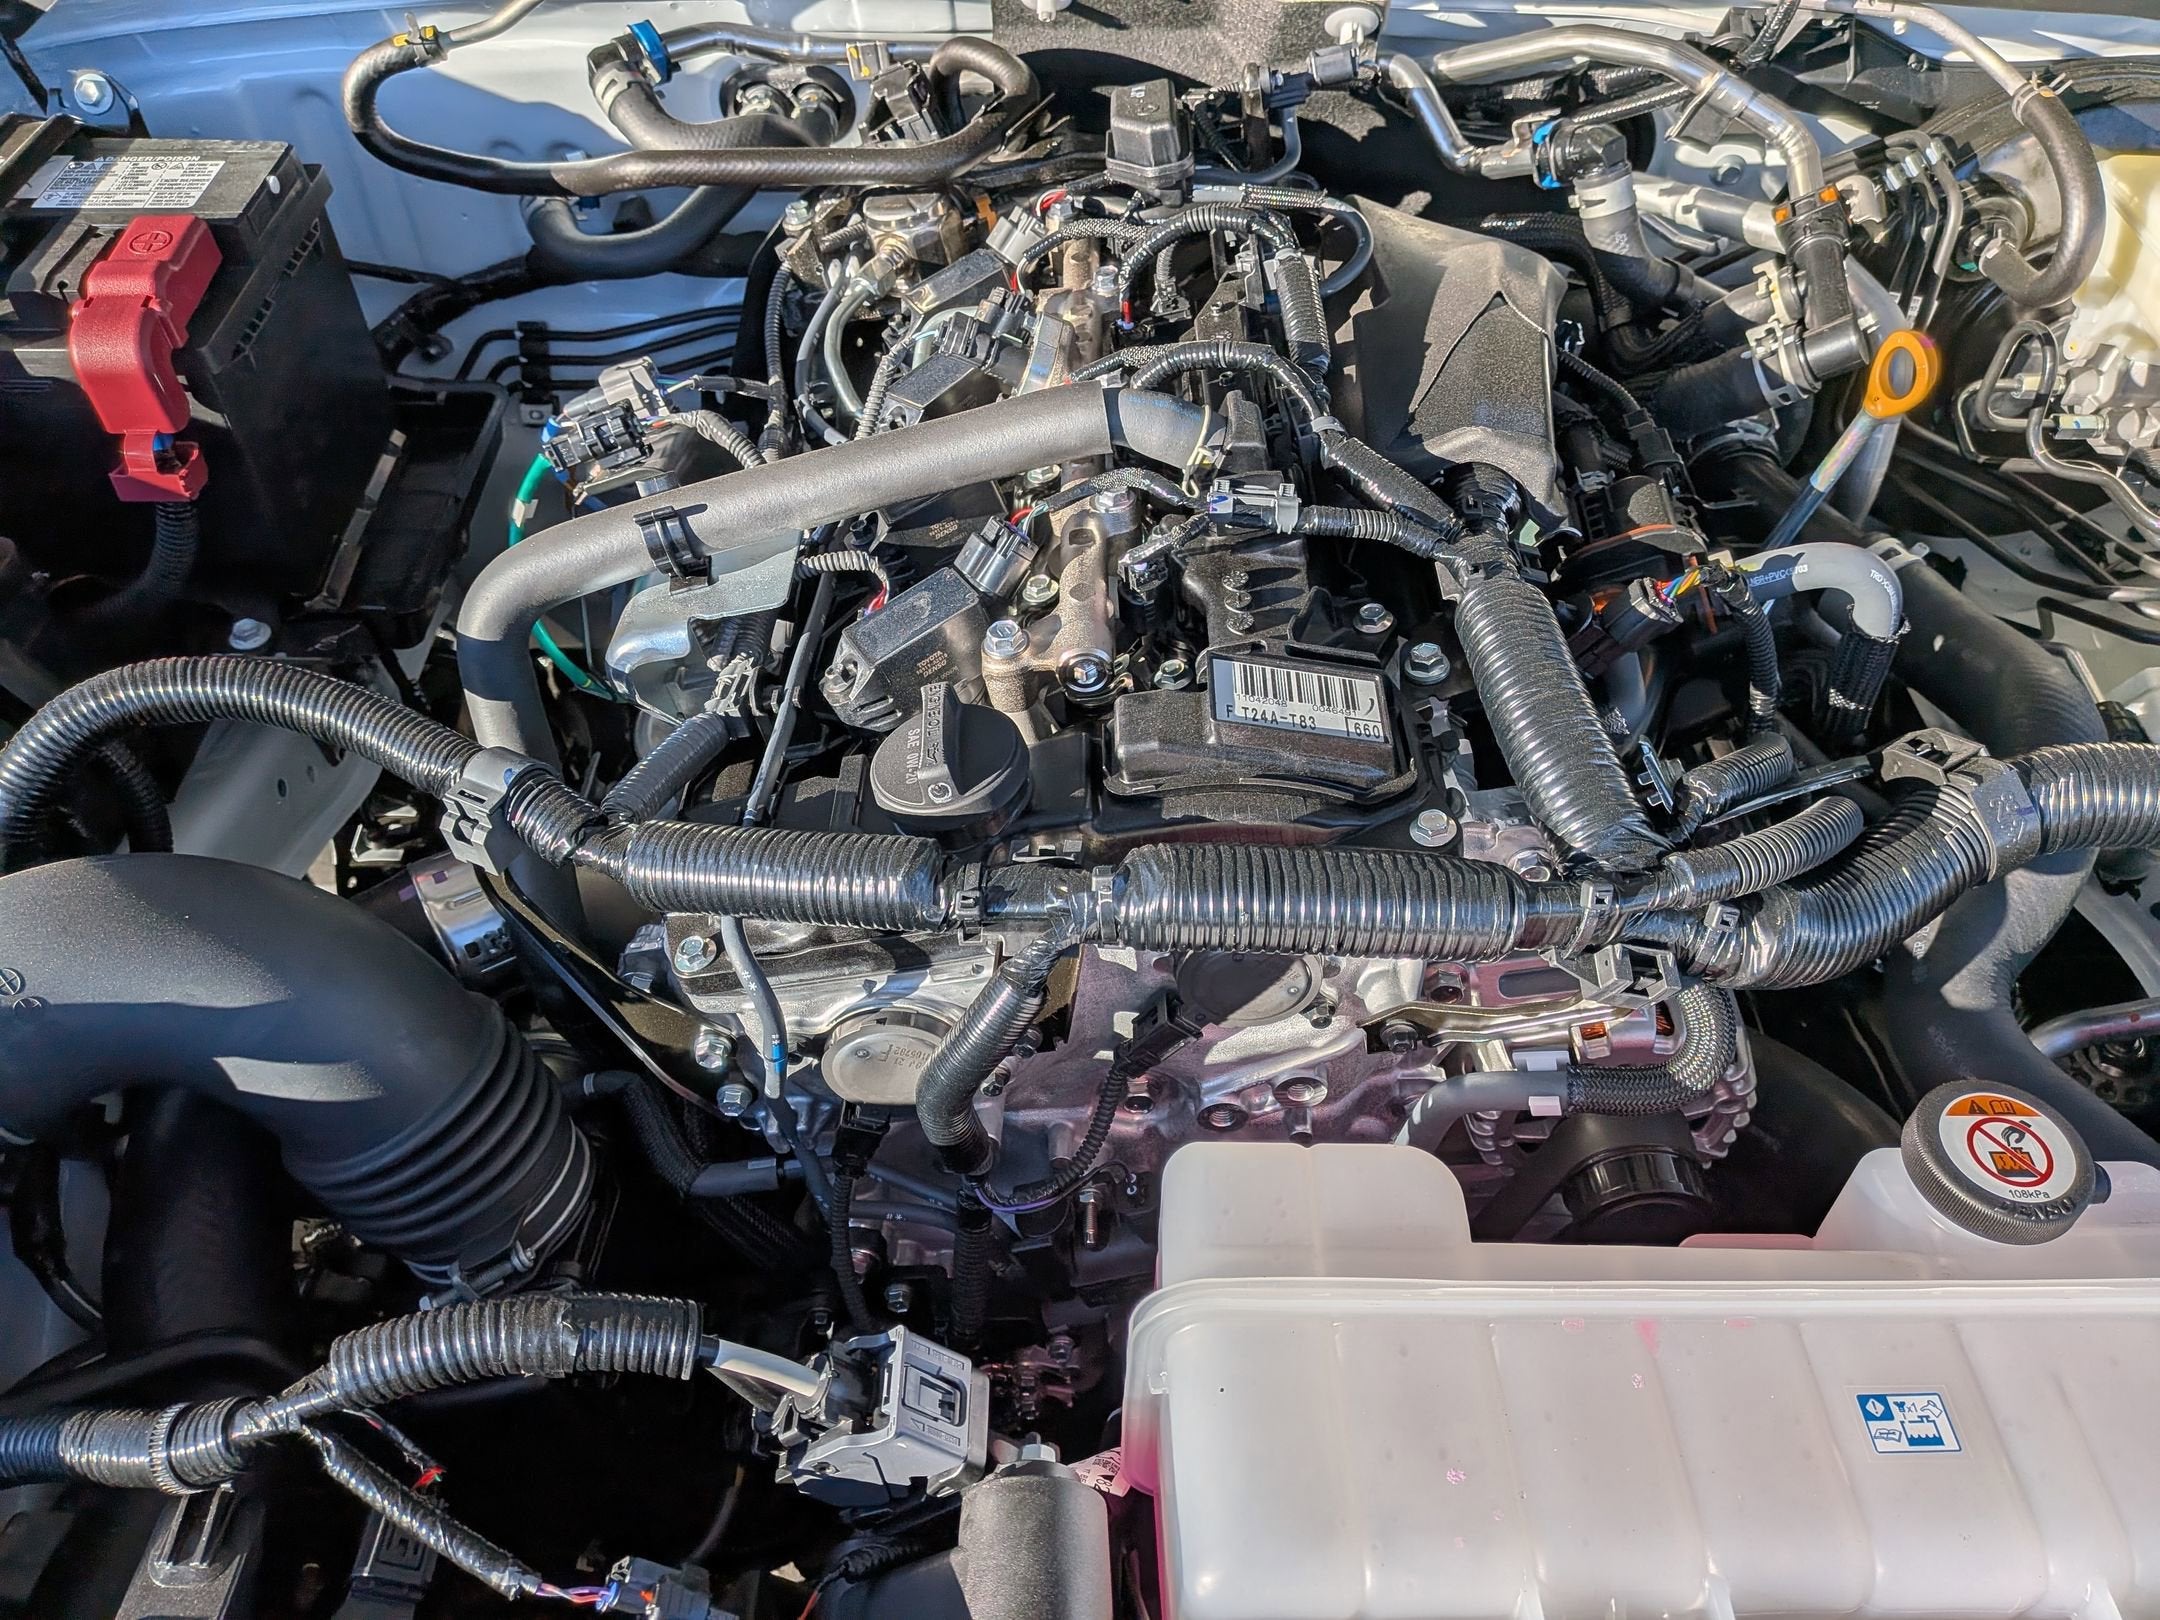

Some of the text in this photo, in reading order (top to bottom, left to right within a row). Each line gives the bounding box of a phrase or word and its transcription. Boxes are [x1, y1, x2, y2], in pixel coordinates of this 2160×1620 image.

[935, 524, 959, 540] DENSO
[916, 650, 943, 669] TOYOTA
[923, 660, 948, 678] DENSO
[1235, 693, 1358, 717] 11042048 0046491
[1226, 704, 1382, 739] F T24A-T83 660
[907, 728, 921, 749] SAE
[2008, 1188, 2050, 1199] 108kPa
